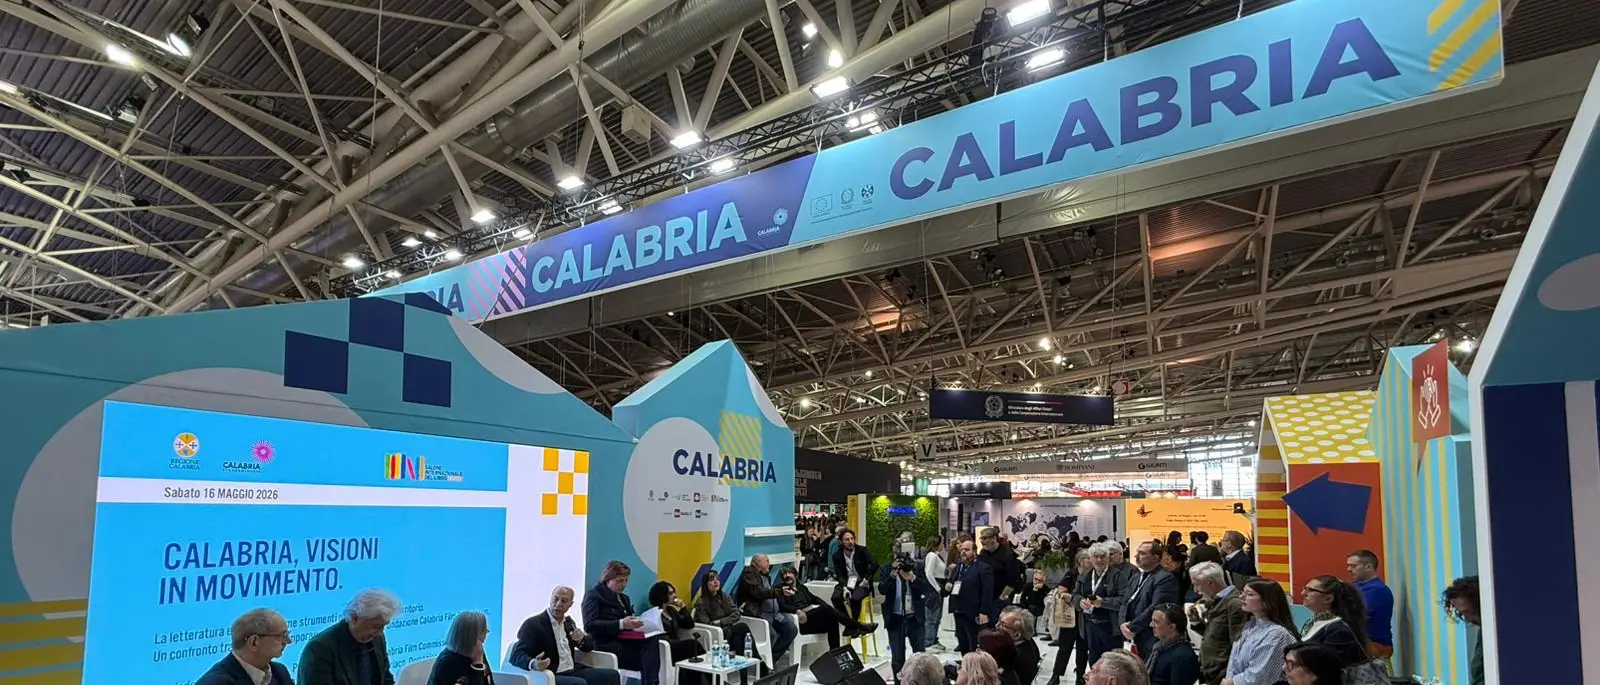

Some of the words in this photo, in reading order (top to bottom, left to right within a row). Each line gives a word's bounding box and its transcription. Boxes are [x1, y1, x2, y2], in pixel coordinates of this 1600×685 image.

[889, 17, 1401, 201] CALABRIA
[757, 225, 780, 236] CALABRIA
[531, 201, 748, 293] CALABRIA
[223, 461, 261, 470] CALABRIA
[672, 448, 777, 483] CALABRIA
[921, 443, 932, 457] V
[164, 487, 200, 498] Sabato
[204, 488, 215, 498] 16
[217, 488, 254, 499] MAGGIO
[256, 489, 279, 500] 2026
[164, 540, 298, 570] CALABRIA,
[306, 537, 379, 563] VISIONI
[159, 576, 187, 605] IN
[195, 567, 343, 602] MOVIMENTO.
[155, 634, 167, 645] La
[170, 628, 225, 643] letteratura
[299, 613, 338, 627] strumenti
[154, 651, 167, 662] Un
[170, 644, 218, 660] confronto
